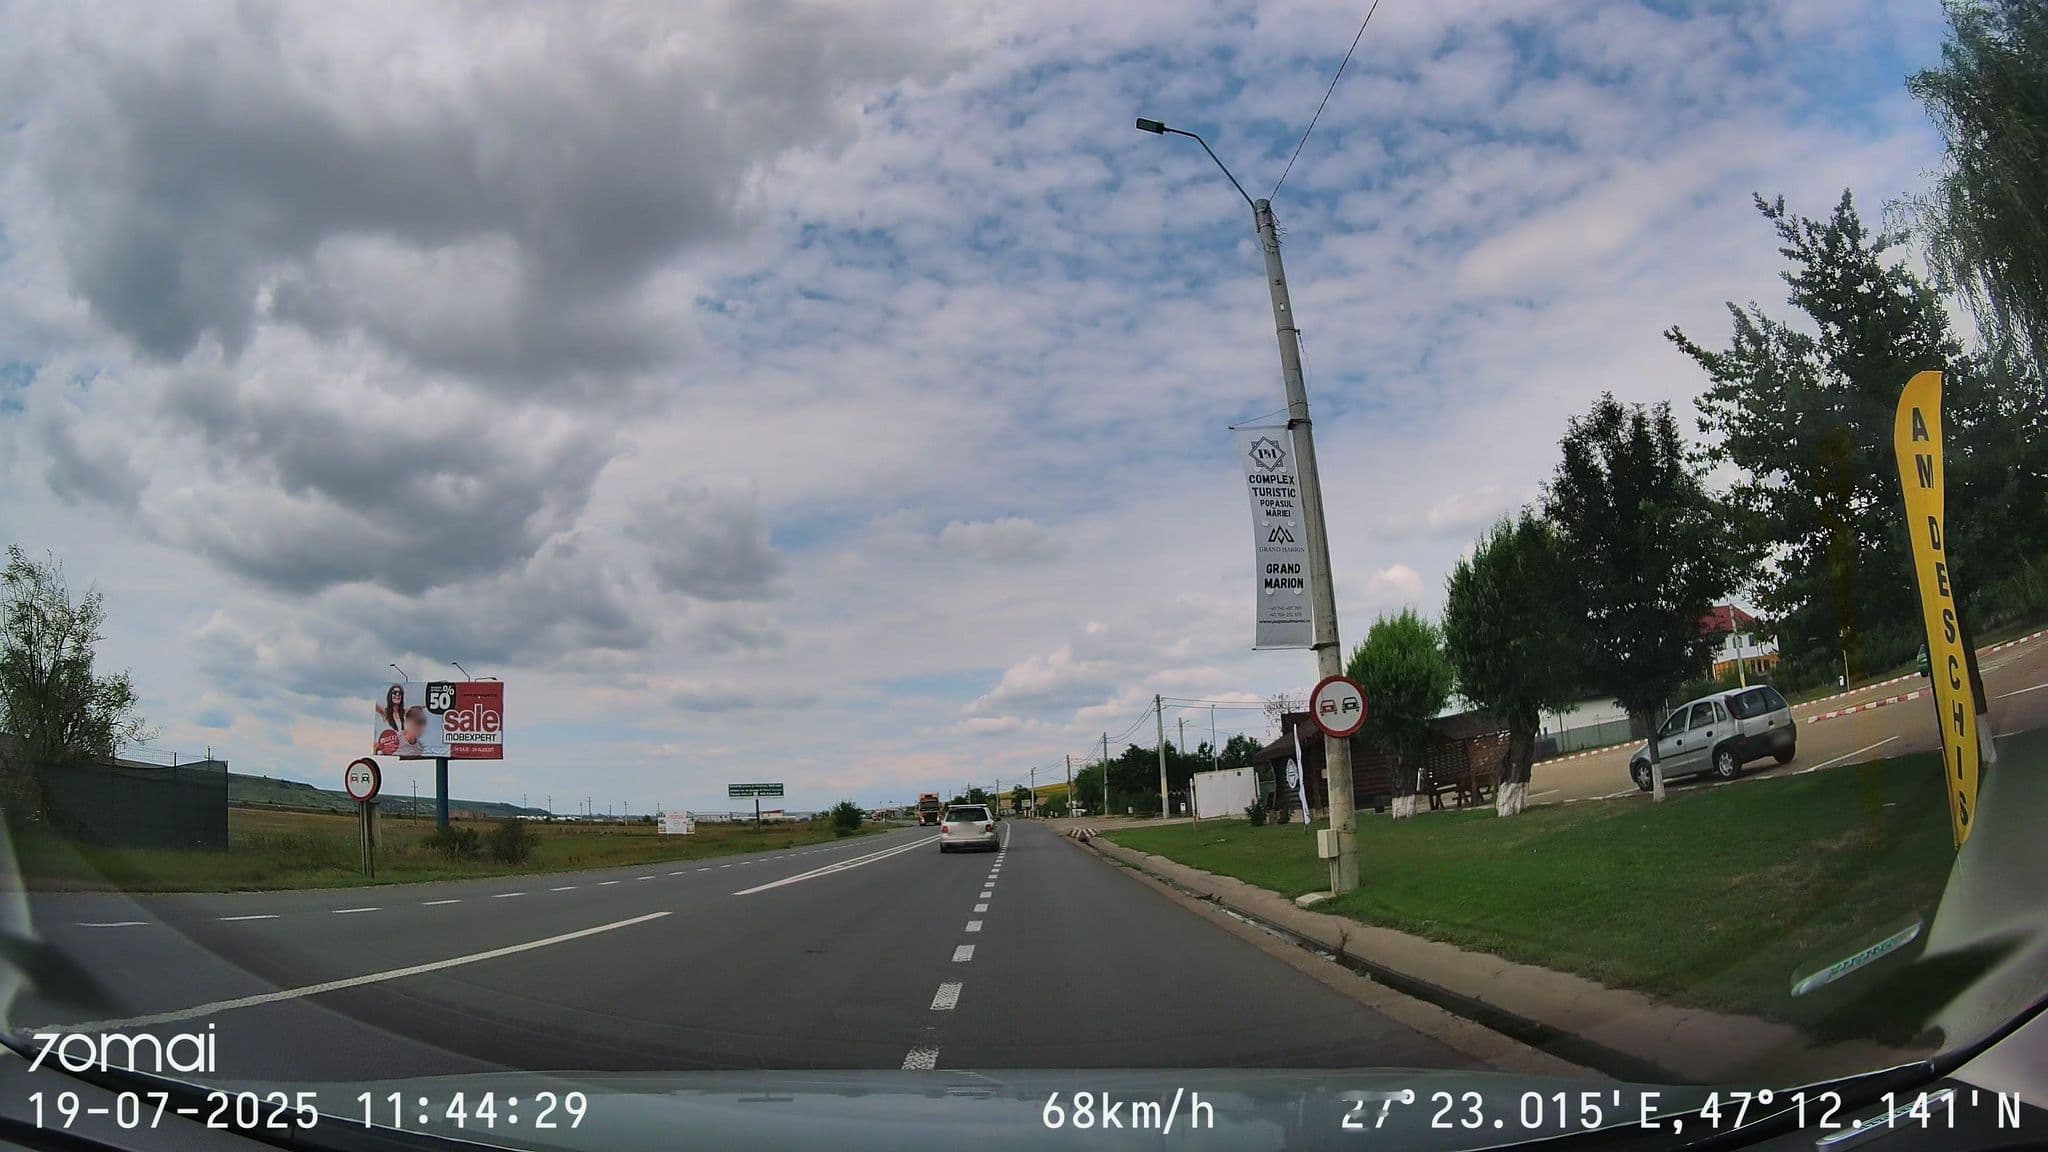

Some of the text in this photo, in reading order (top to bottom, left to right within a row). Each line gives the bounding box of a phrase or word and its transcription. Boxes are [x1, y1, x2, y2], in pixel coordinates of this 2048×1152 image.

[1248, 474, 1296, 486] COMPLEX
[1251, 487, 1297, 498] TURISTIC
[1259, 498, 1294, 508] POPASUL
[1266, 563, 1301, 574] GRAND
[1264, 577, 1304, 589] MARION
[443, 704, 500, 733] sale
[445, 733, 496, 742] MOBEXPERT
